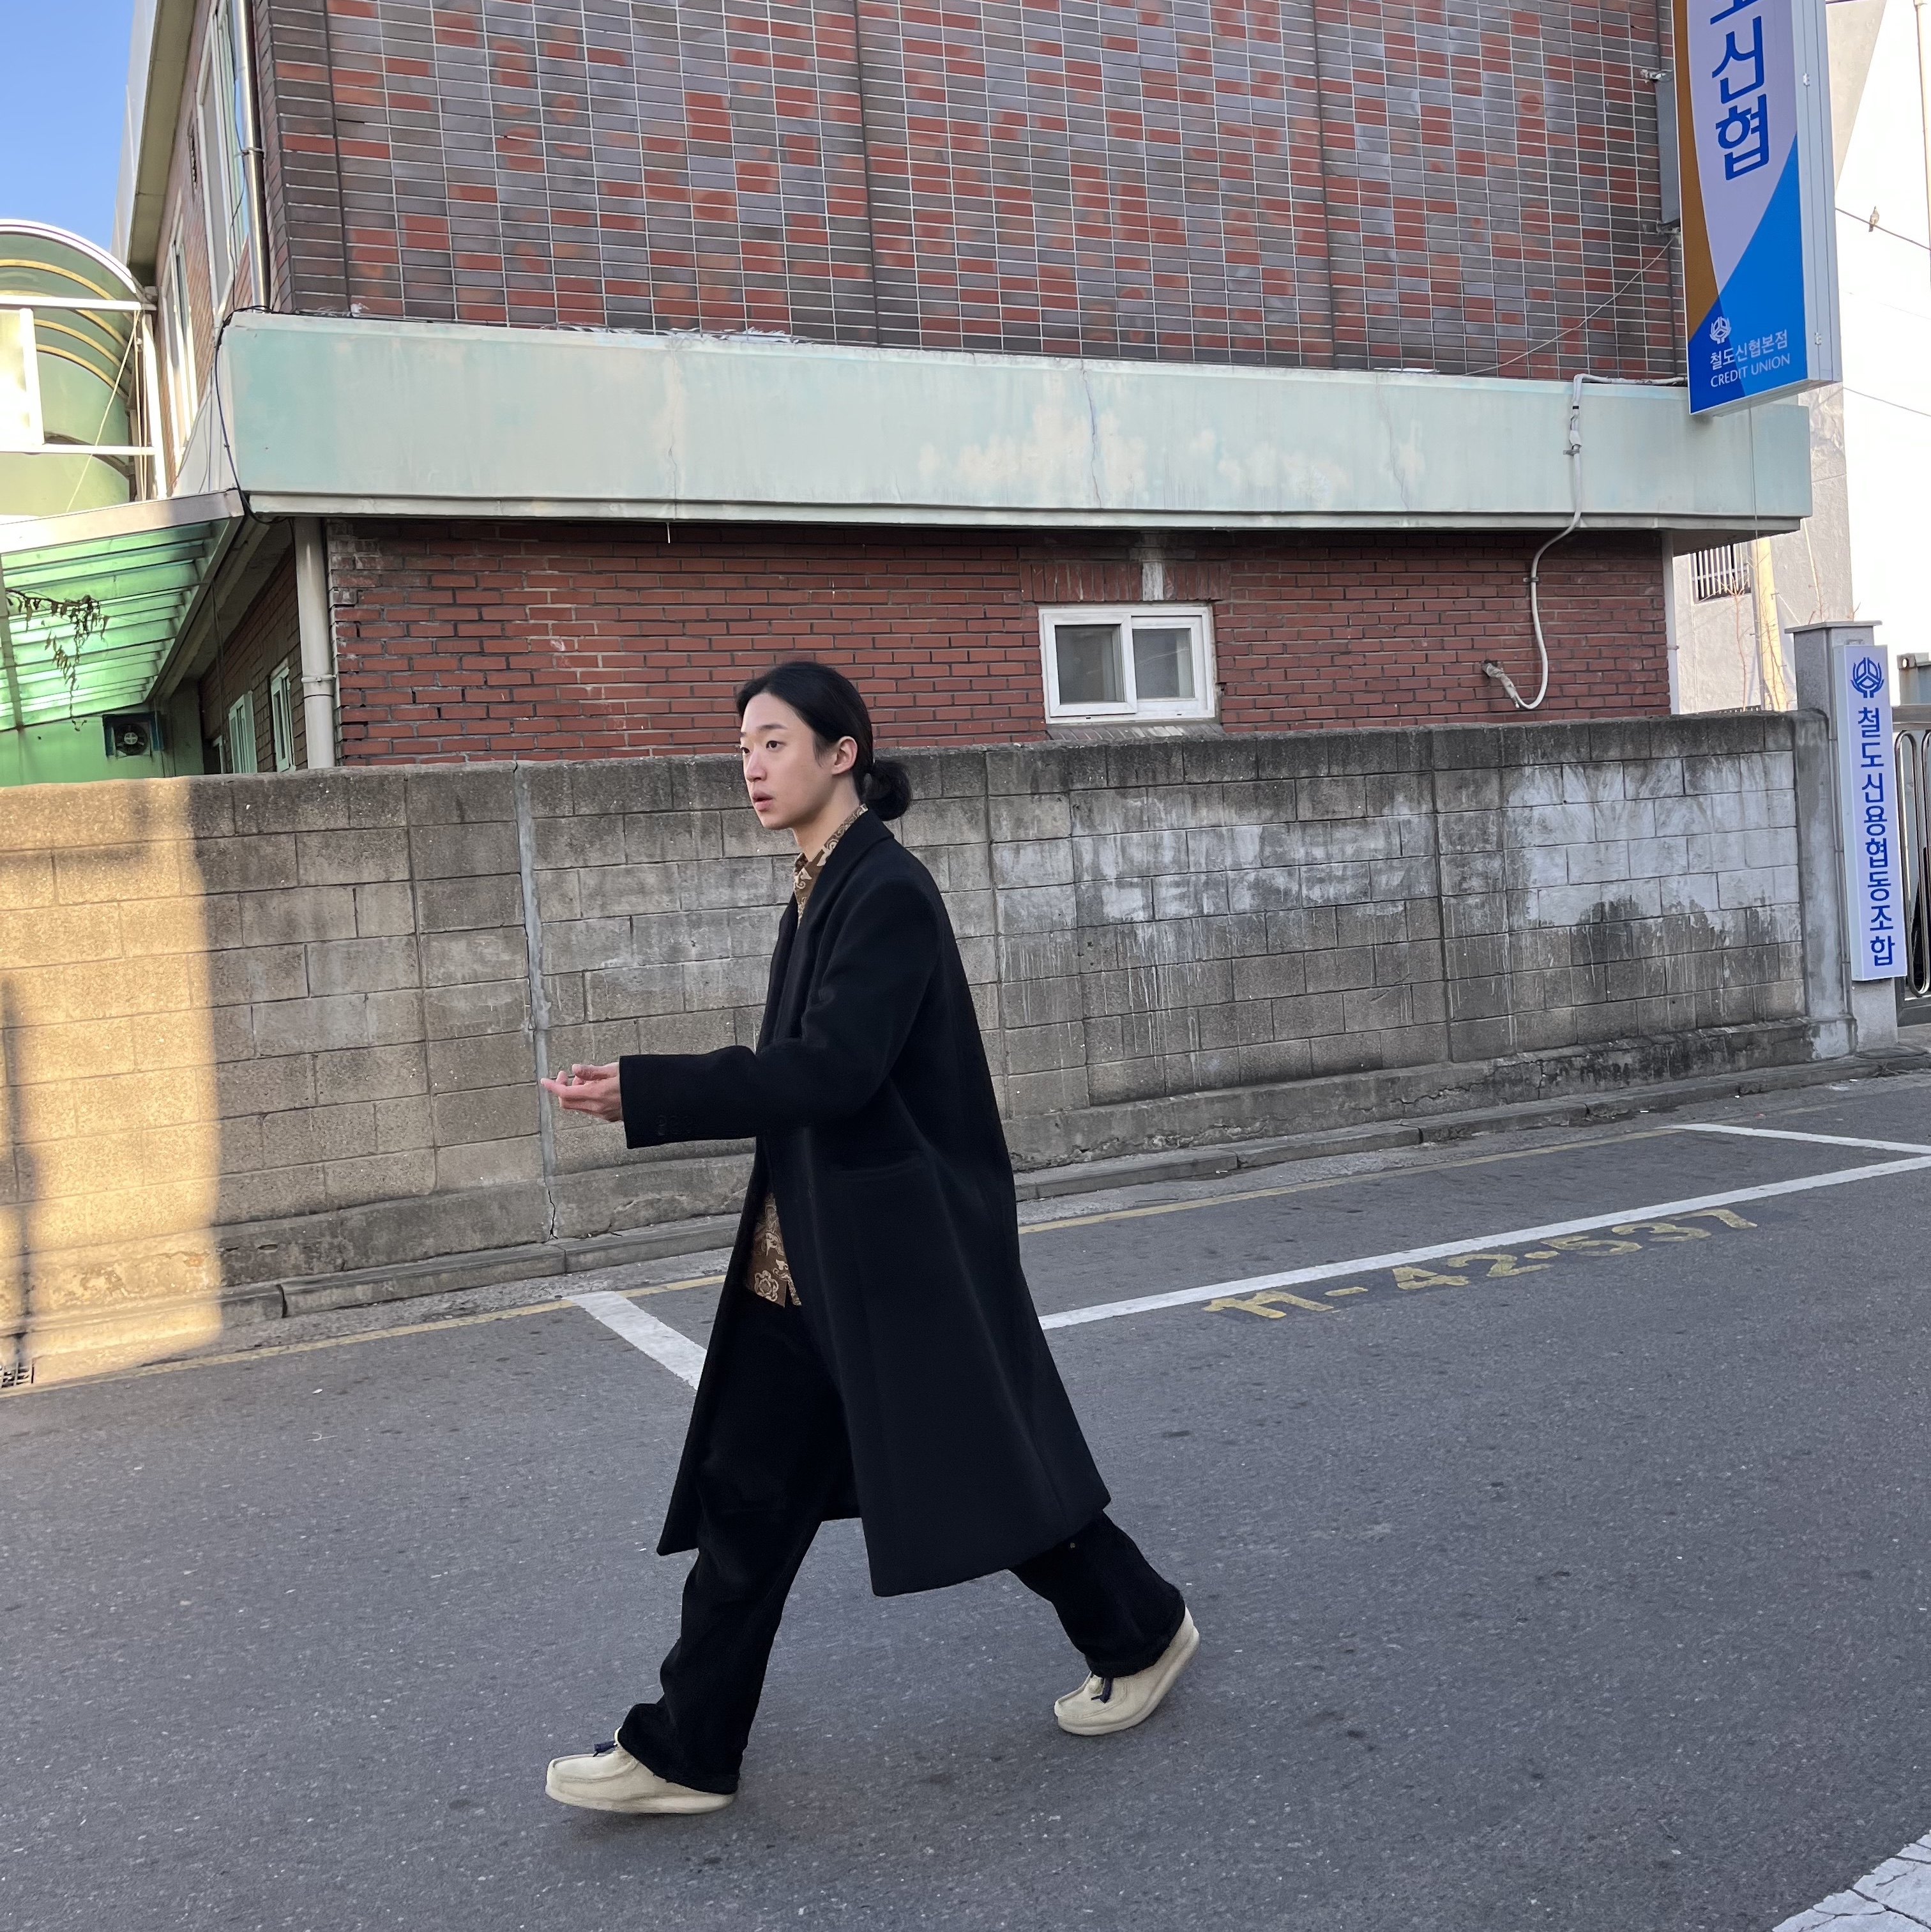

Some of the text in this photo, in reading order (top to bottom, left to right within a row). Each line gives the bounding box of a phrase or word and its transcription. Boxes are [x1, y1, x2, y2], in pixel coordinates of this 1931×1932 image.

[1710, 329, 1787, 370] 철도신협본점
[1711, 353, 1791, 387] CREDIT UNION
[1858, 706, 1895, 966] 철도신용협동조합
